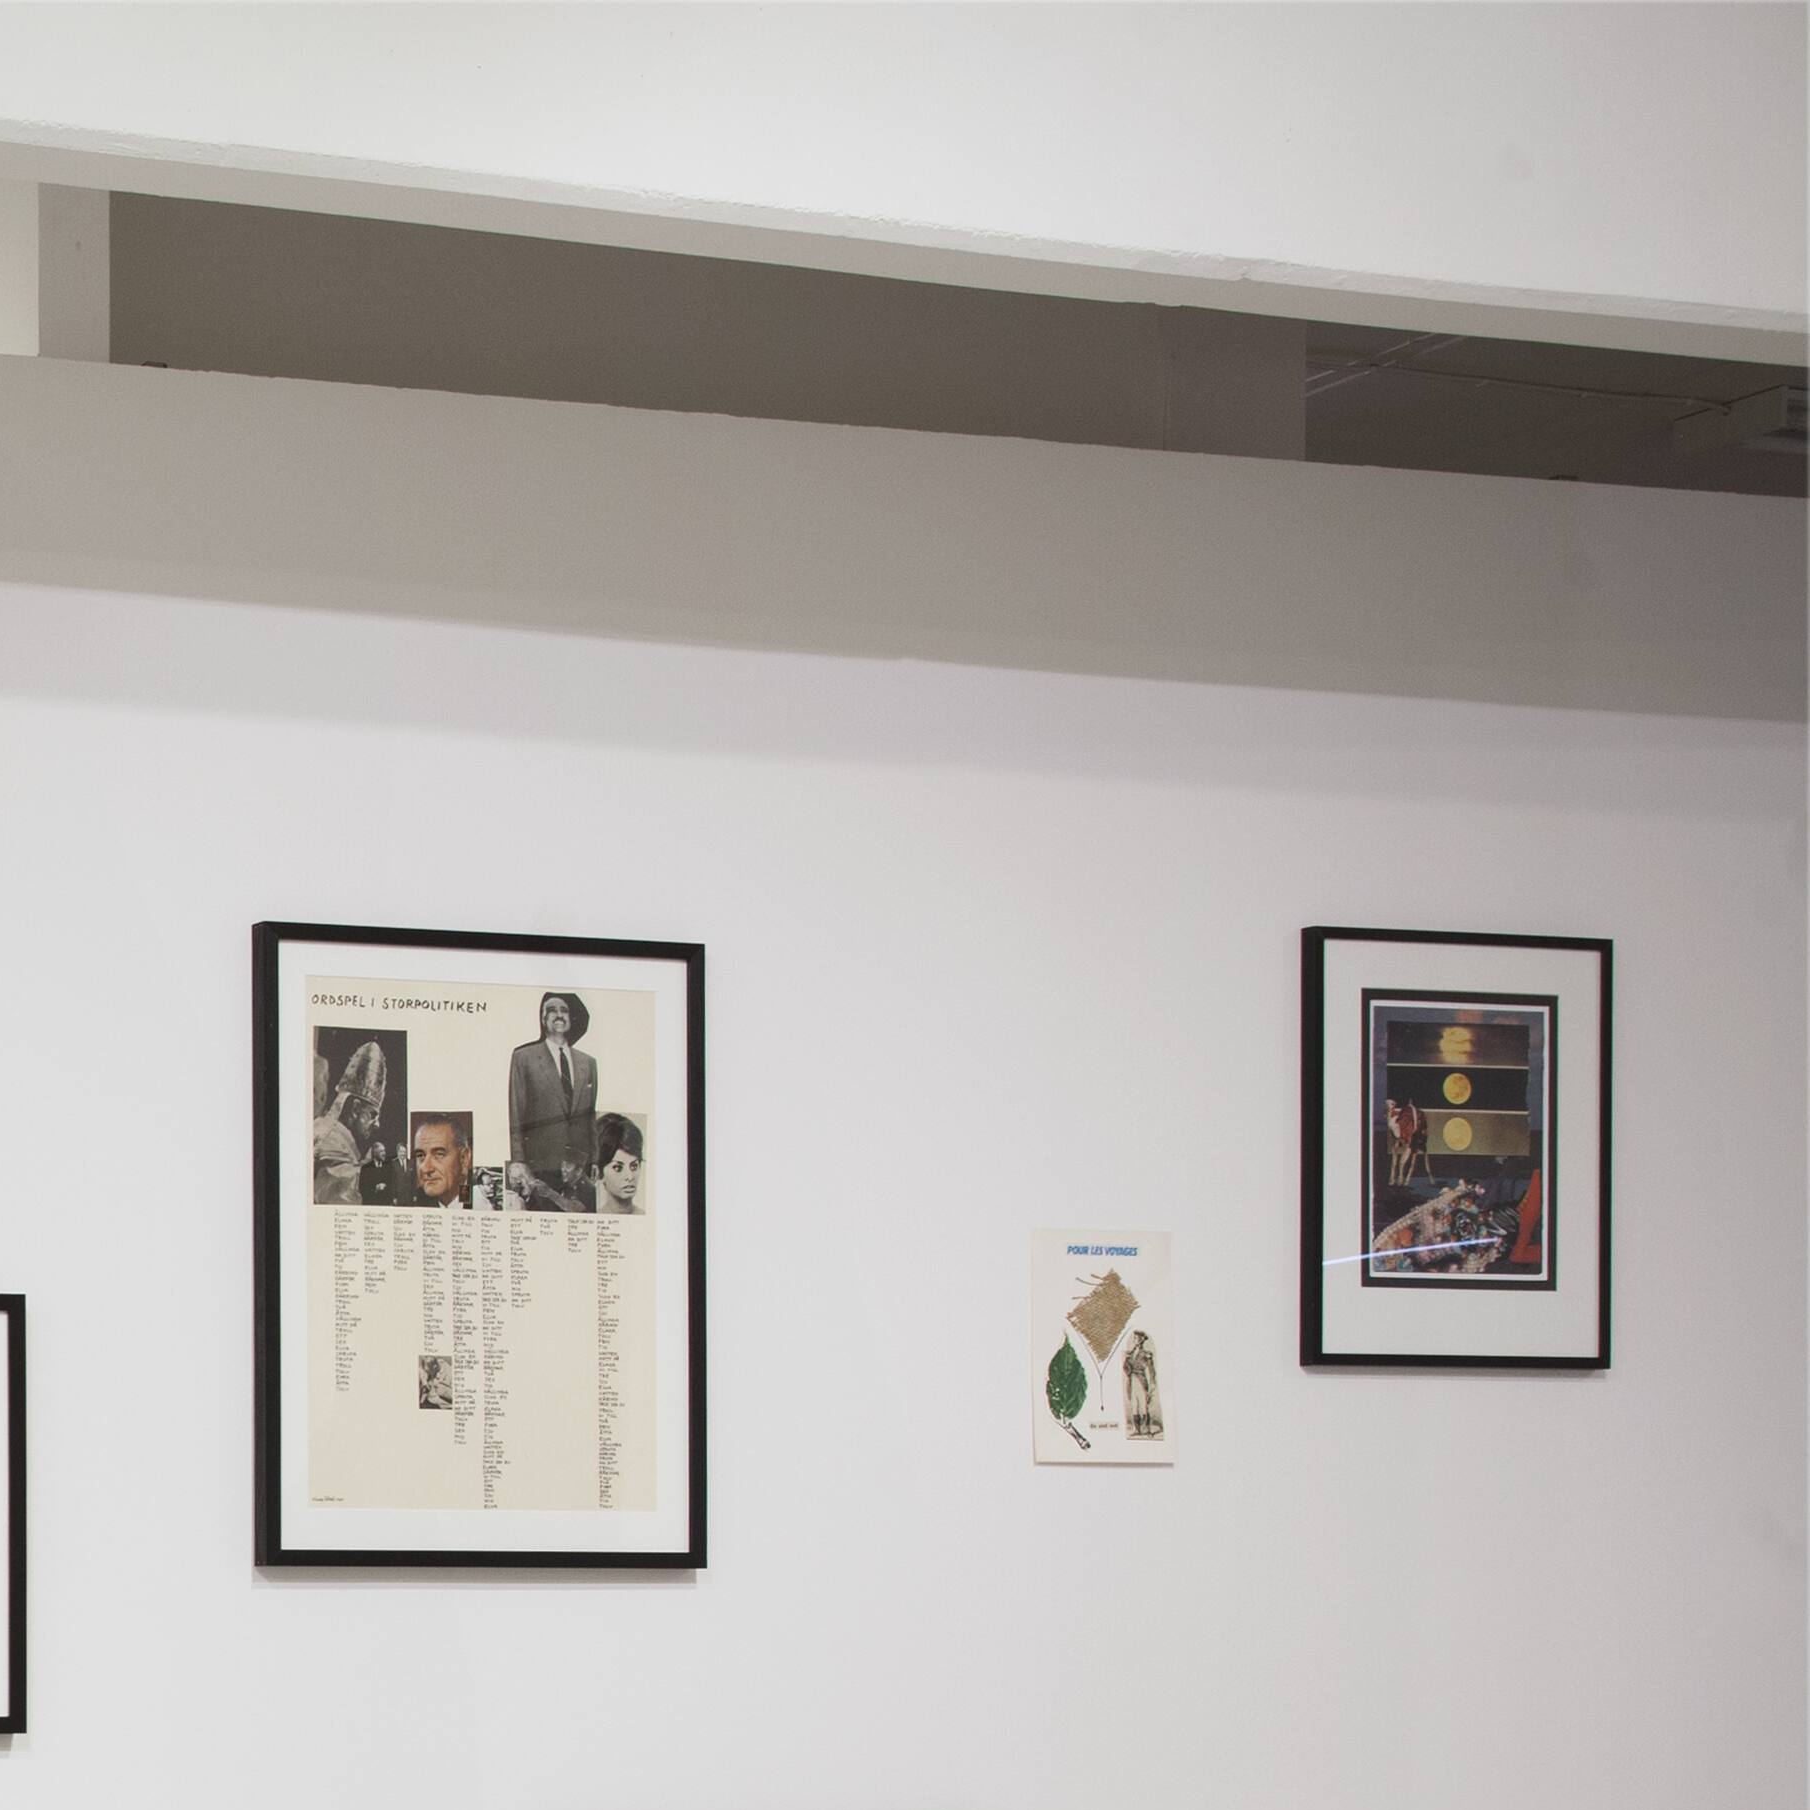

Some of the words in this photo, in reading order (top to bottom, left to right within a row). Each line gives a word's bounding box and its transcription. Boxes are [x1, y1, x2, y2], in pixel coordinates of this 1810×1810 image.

[311, 993, 366, 1008] ORDSPEL
[370, 997, 375, 1008] I
[382, 997, 487, 1014] STORPOLITIKEN
[1067, 1245, 1089, 1255] POUR
[1090, 1246, 1103, 1256] LES
[1104, 1246, 1138, 1257] VOYAGES
